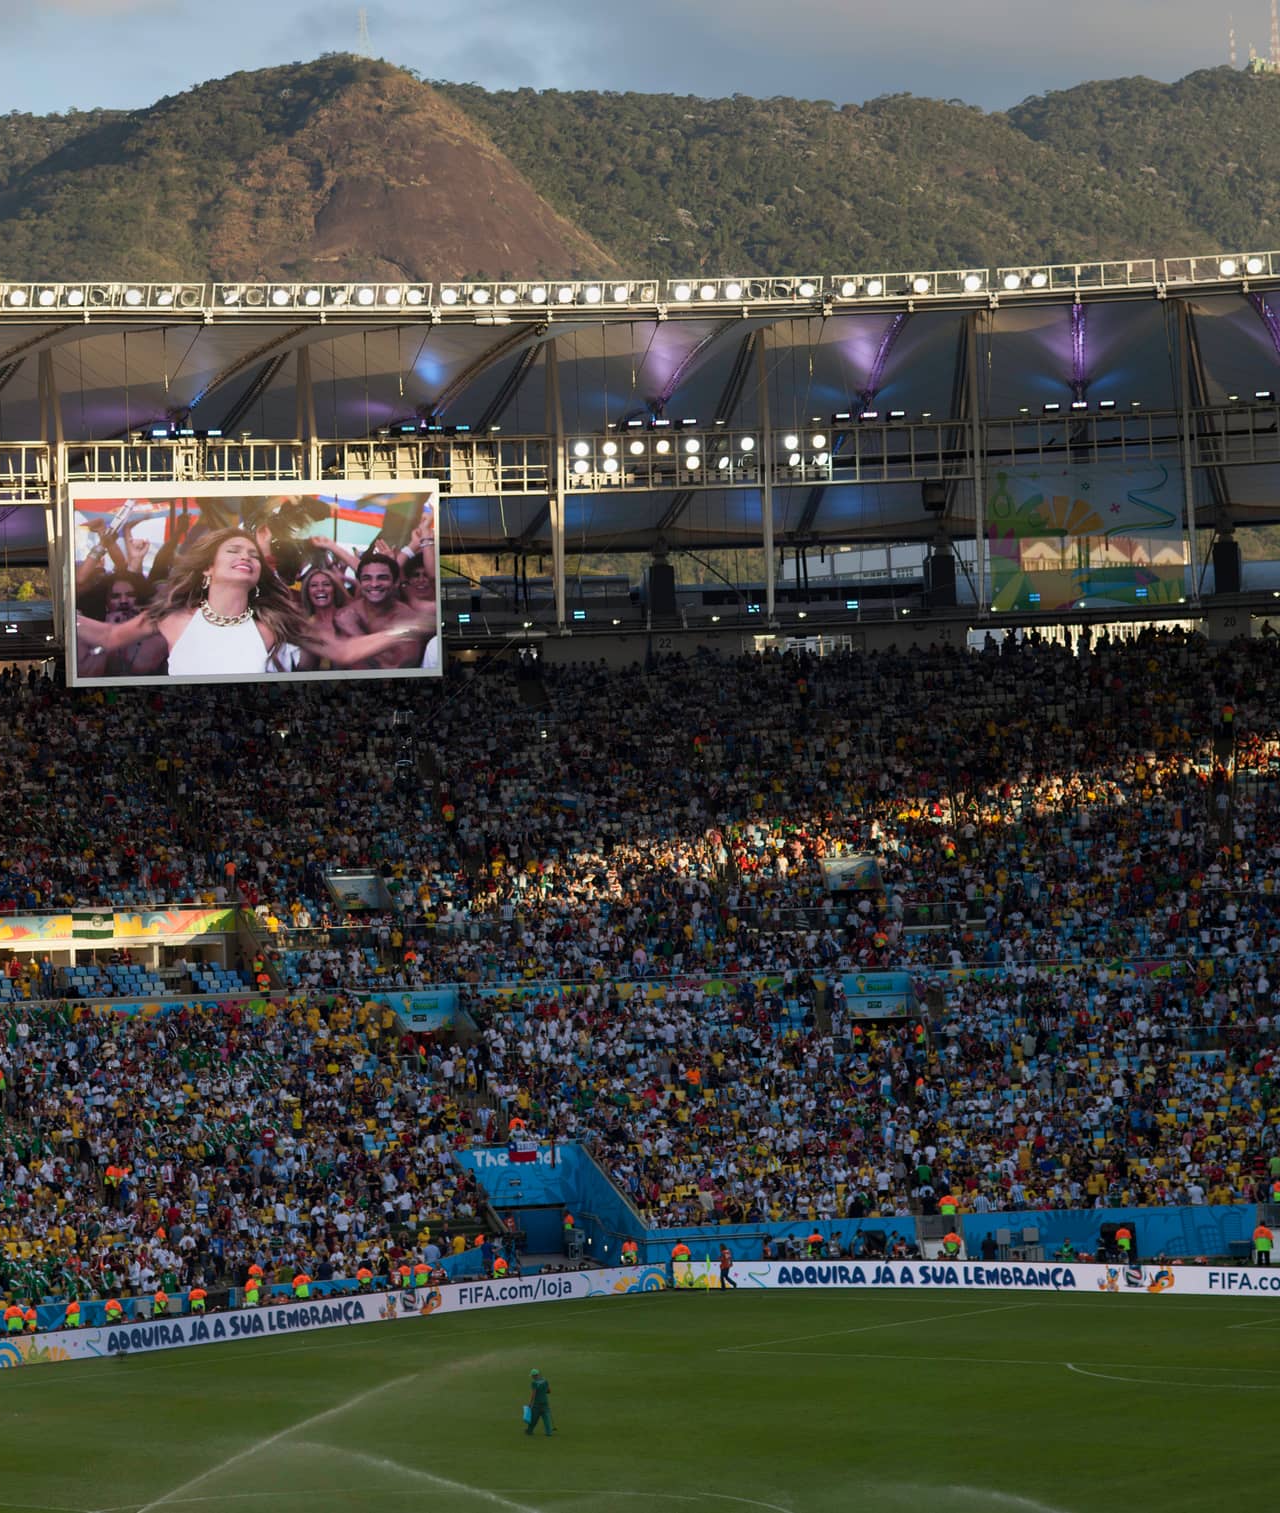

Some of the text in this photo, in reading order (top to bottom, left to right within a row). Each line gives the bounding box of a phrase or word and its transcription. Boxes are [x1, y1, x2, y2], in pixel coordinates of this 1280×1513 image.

[659, 639, 671, 649] 22
[473, 1150, 508, 1168] The
[778, 1260, 1076, 1290] ADQUIRA JÁ A SUA LEMBRANÇA
[458, 1277, 573, 1305] FIFA.com/loja
[107, 1301, 366, 1353] ADQUIRA JÁ A SUA LEMBRANÇA
